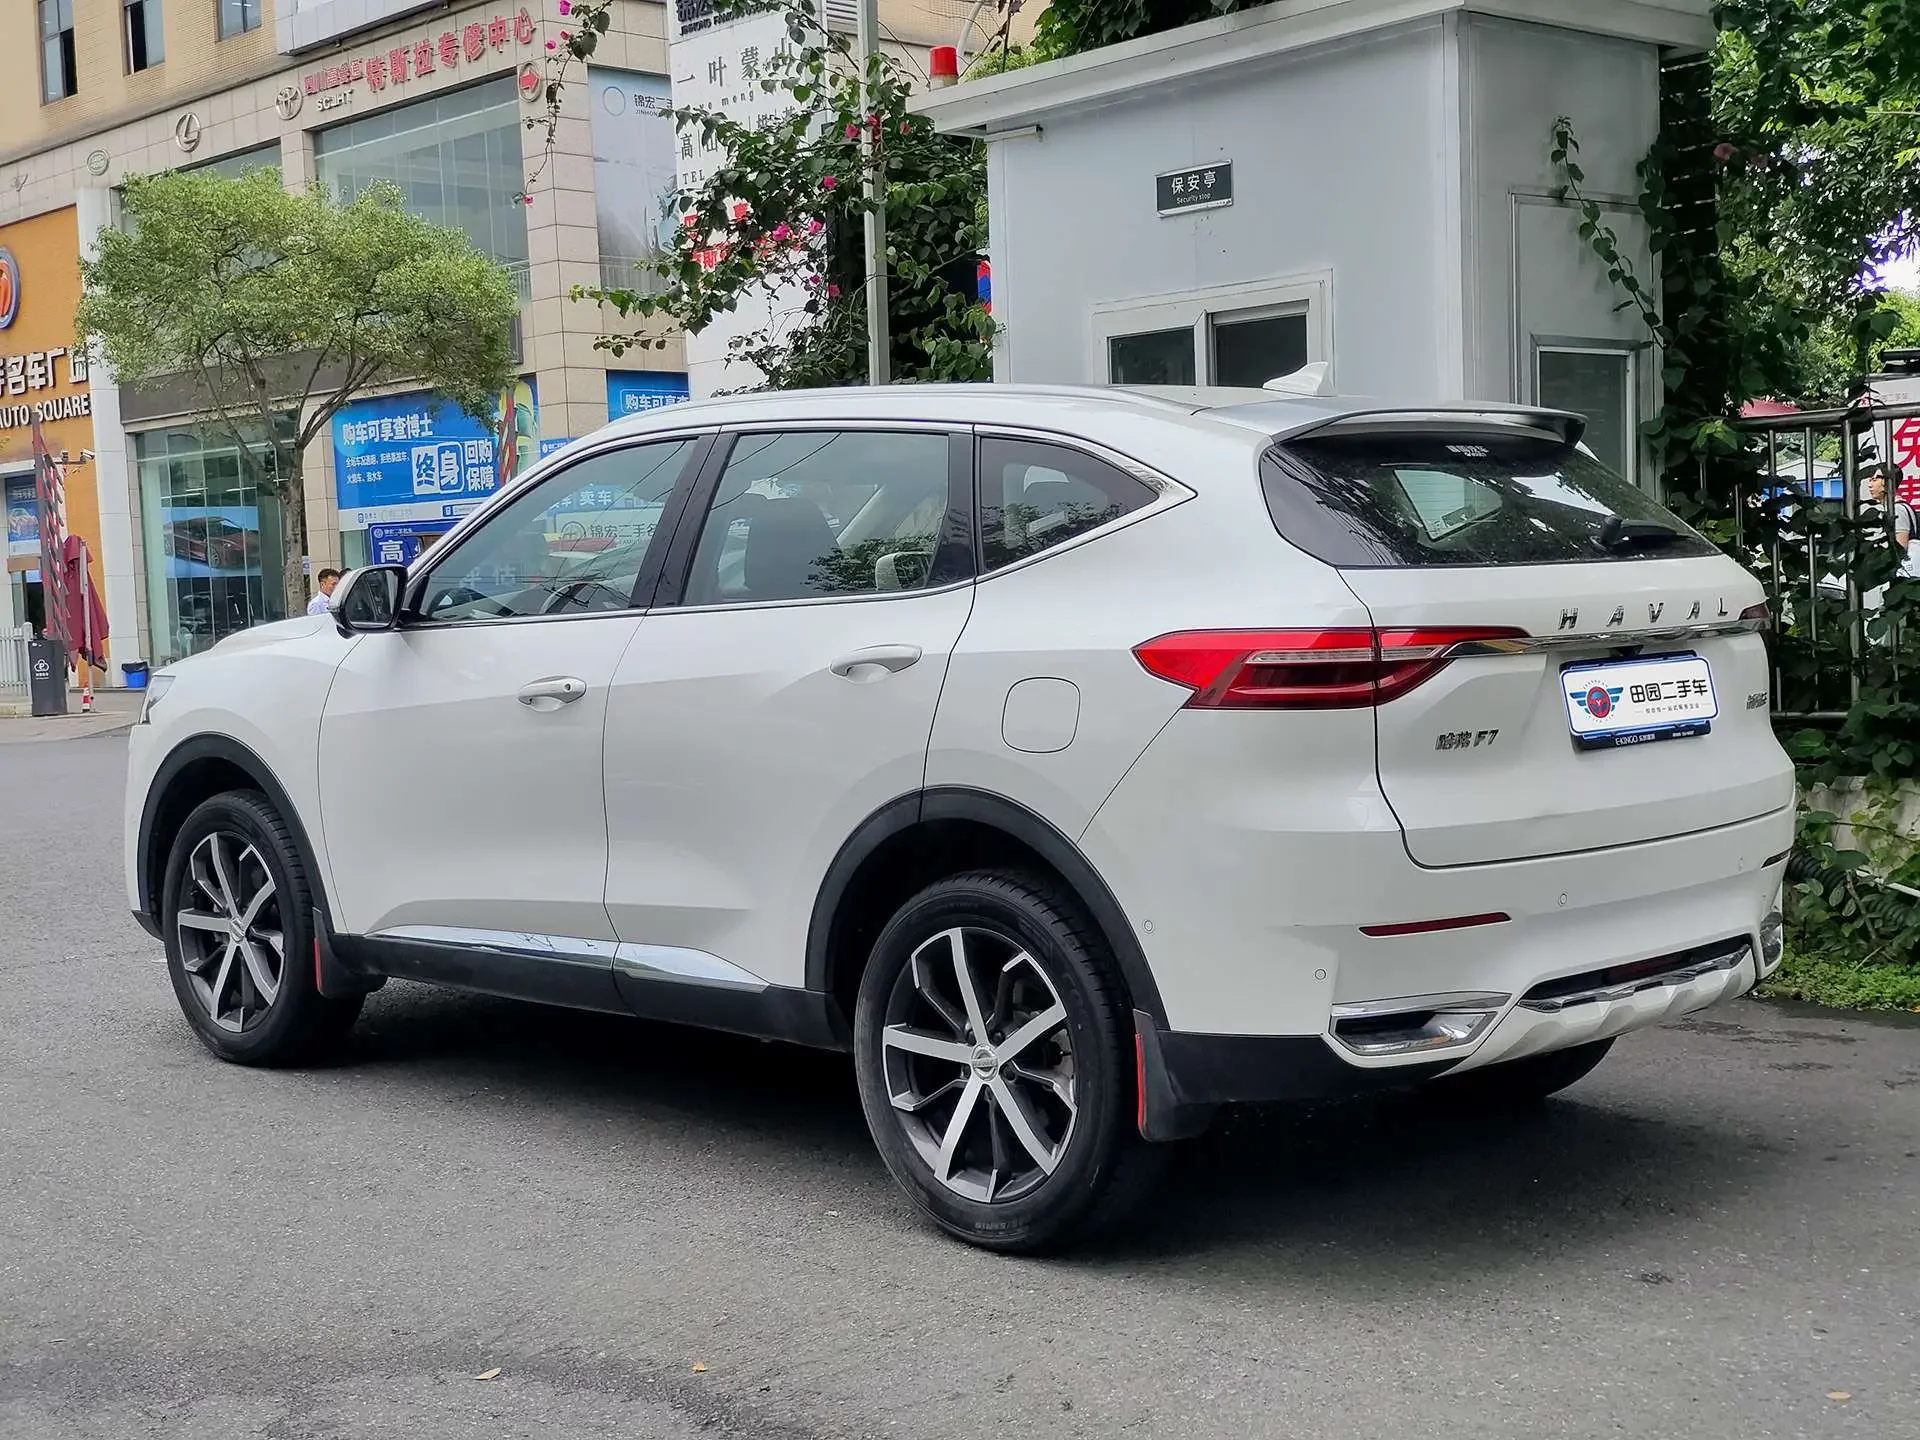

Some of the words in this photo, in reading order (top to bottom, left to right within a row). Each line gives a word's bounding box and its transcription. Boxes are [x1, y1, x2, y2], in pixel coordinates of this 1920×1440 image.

[365, 7, 536, 93] 特斯拉专修中心
[677, 37, 794, 87] 一叶蒙山
[683, 169, 706, 185] TEL
[1172, 170, 1216, 195] 保安亭
[35, 393, 89, 421] SQUARE
[342, 413, 433, 445] 购车可享查博士
[464, 438, 493, 465] 回购
[415, 450, 460, 487] 终身
[466, 465, 495, 492] 保障
[579, 490, 613, 506] 卖车
[379, 540, 404, 563] 高
[1558, 597, 1729, 630] HAVAL
[1629, 678, 1709, 704] 田园二手车
[1473, 729, 1499, 747] F7
